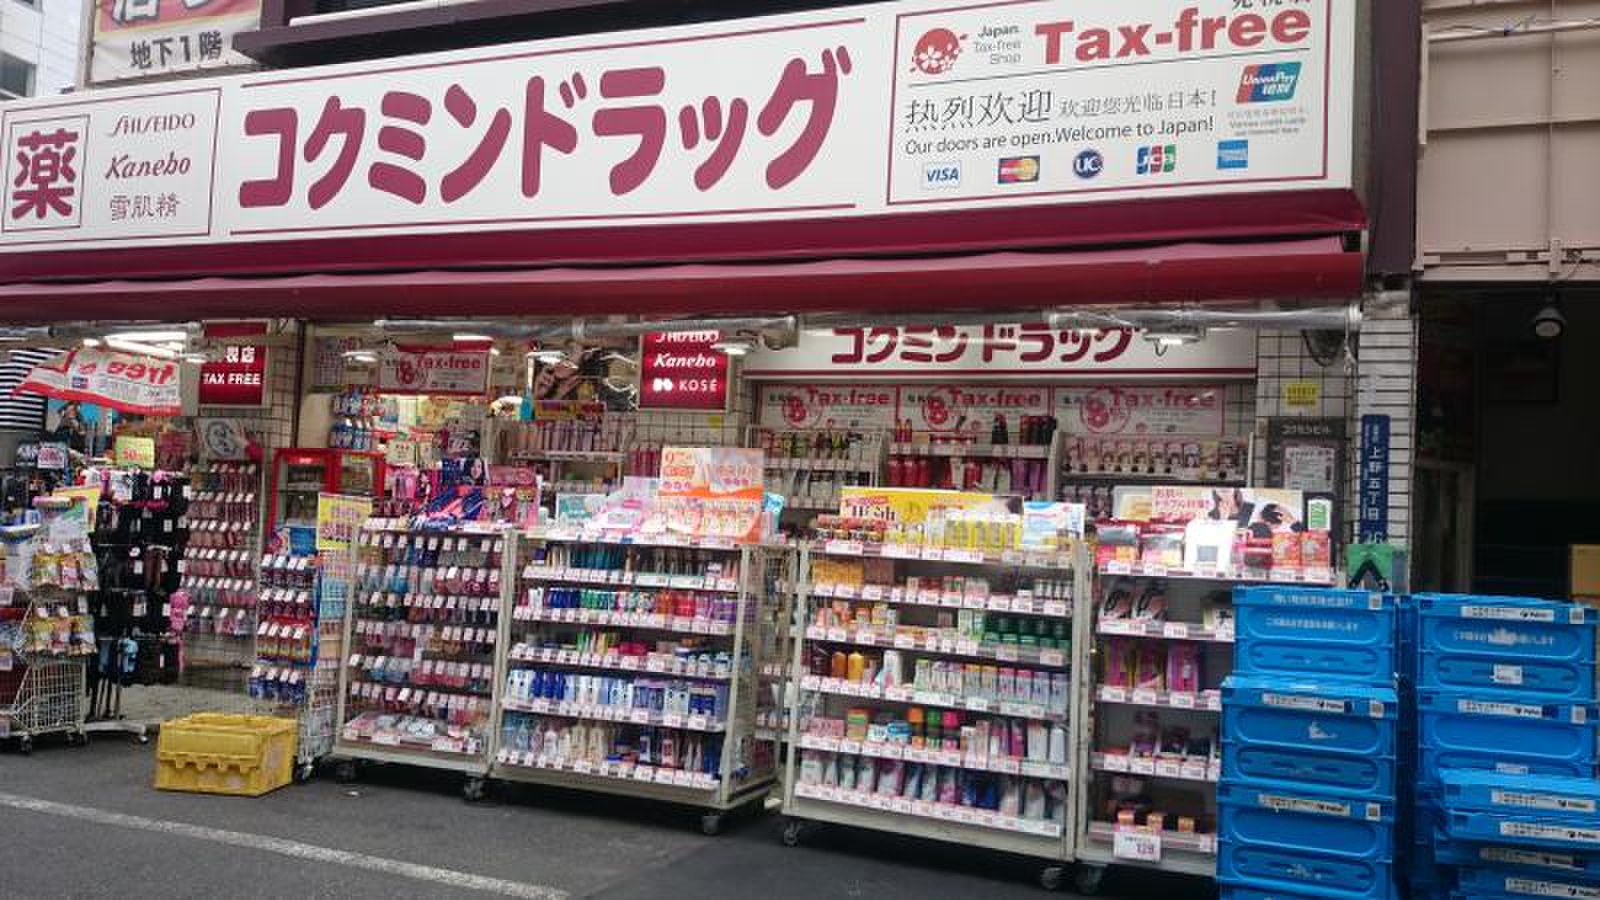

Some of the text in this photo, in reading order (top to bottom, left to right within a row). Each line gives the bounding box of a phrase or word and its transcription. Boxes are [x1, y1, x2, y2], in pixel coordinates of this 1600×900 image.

[130, 31, 223, 69] 地下1階
[1035, 7, 1311, 65] Tax-free
[107, 113, 196, 138] SHISEIDO
[239, 45, 852, 211] コクミンドラッグ
[905, 89, 1052, 134] 热烈欢迎
[905, 139, 933, 155] Our
[937, 137, 979, 153] doors
[983, 135, 1008, 149] are
[1136, 122, 1153, 137] to
[12, 128, 79, 220] 薬
[105, 151, 191, 179] Kanebo
[927, 166, 960, 182] VISA
[654, 353, 716, 368] Kanebo
[831, 324, 1145, 363] コクミンドラッグ
[203, 373, 261, 385] TAX FREE
[1367, 445, 1382, 521] 上野五丁目
